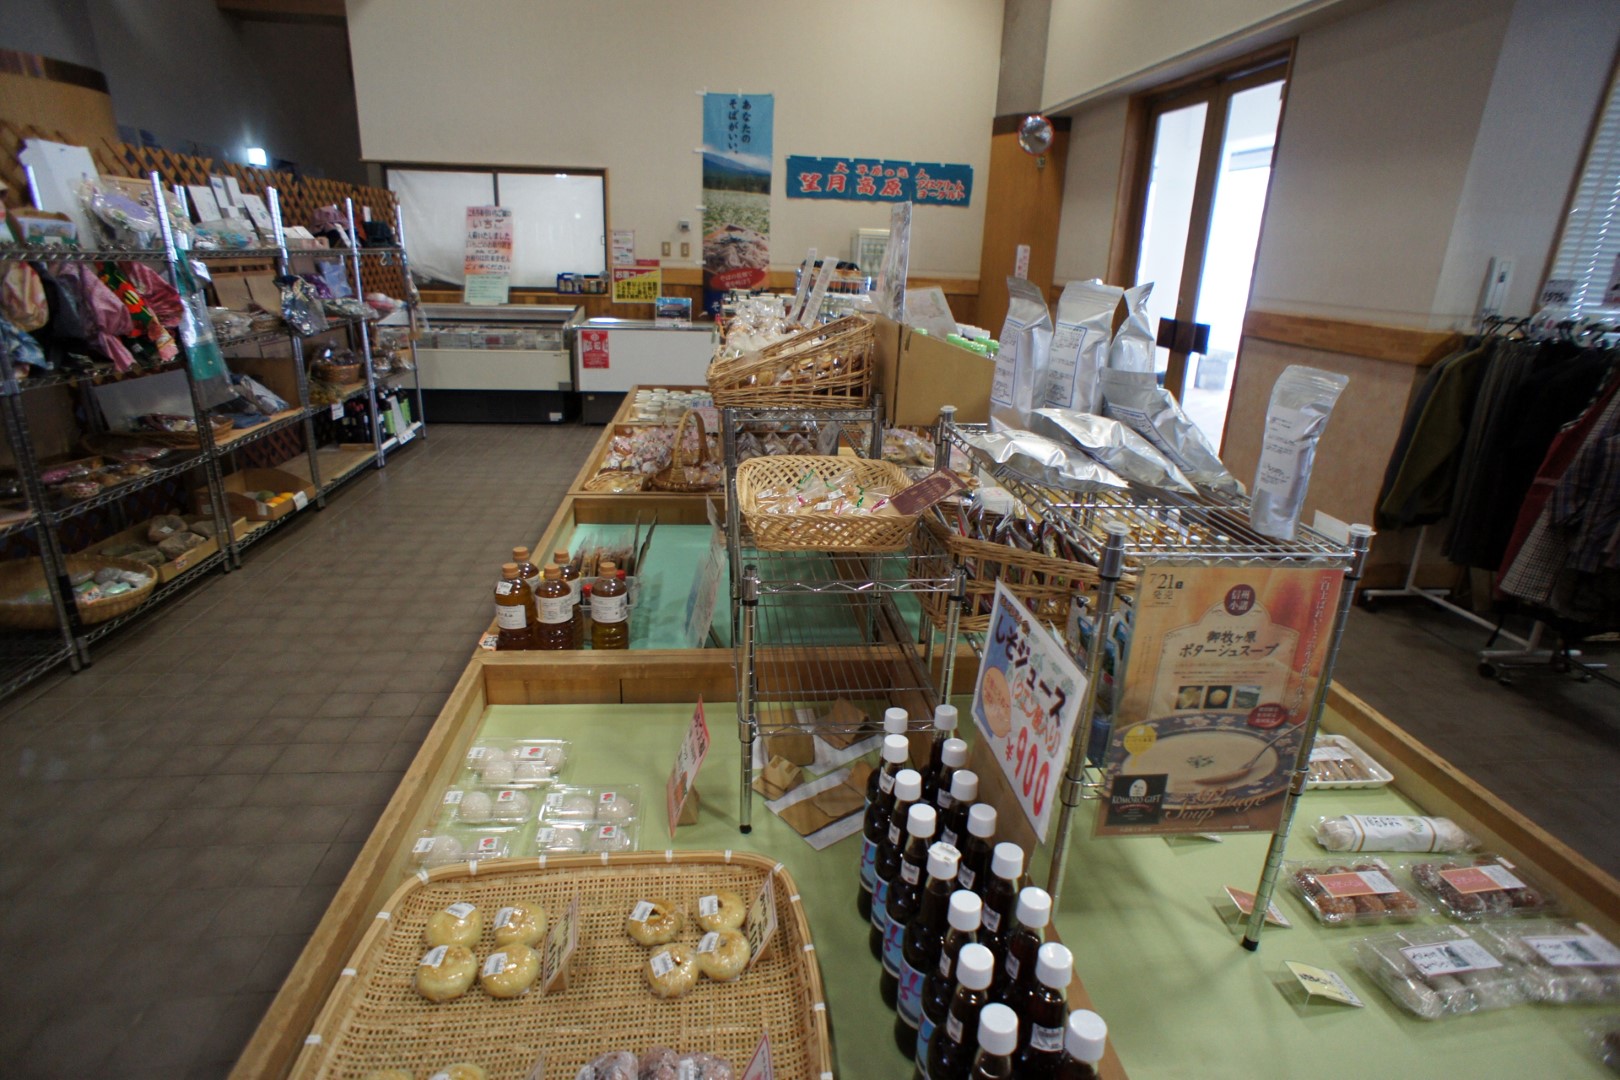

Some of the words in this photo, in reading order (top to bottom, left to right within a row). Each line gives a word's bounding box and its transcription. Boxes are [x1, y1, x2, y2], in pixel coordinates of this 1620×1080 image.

[742, 99, 751, 144] あなたの
[799, 172, 902, 197] 望月高原
[916, 189, 966, 201] ヨーグルト
[1231, 590, 1250, 600] 信州
[1229, 600, 1248, 611] 小諸
[1179, 642, 1280, 658] ポタージュスープ
[995, 616, 1066, 727] しそジュース
[1004, 726, 1049, 817] ¥900
